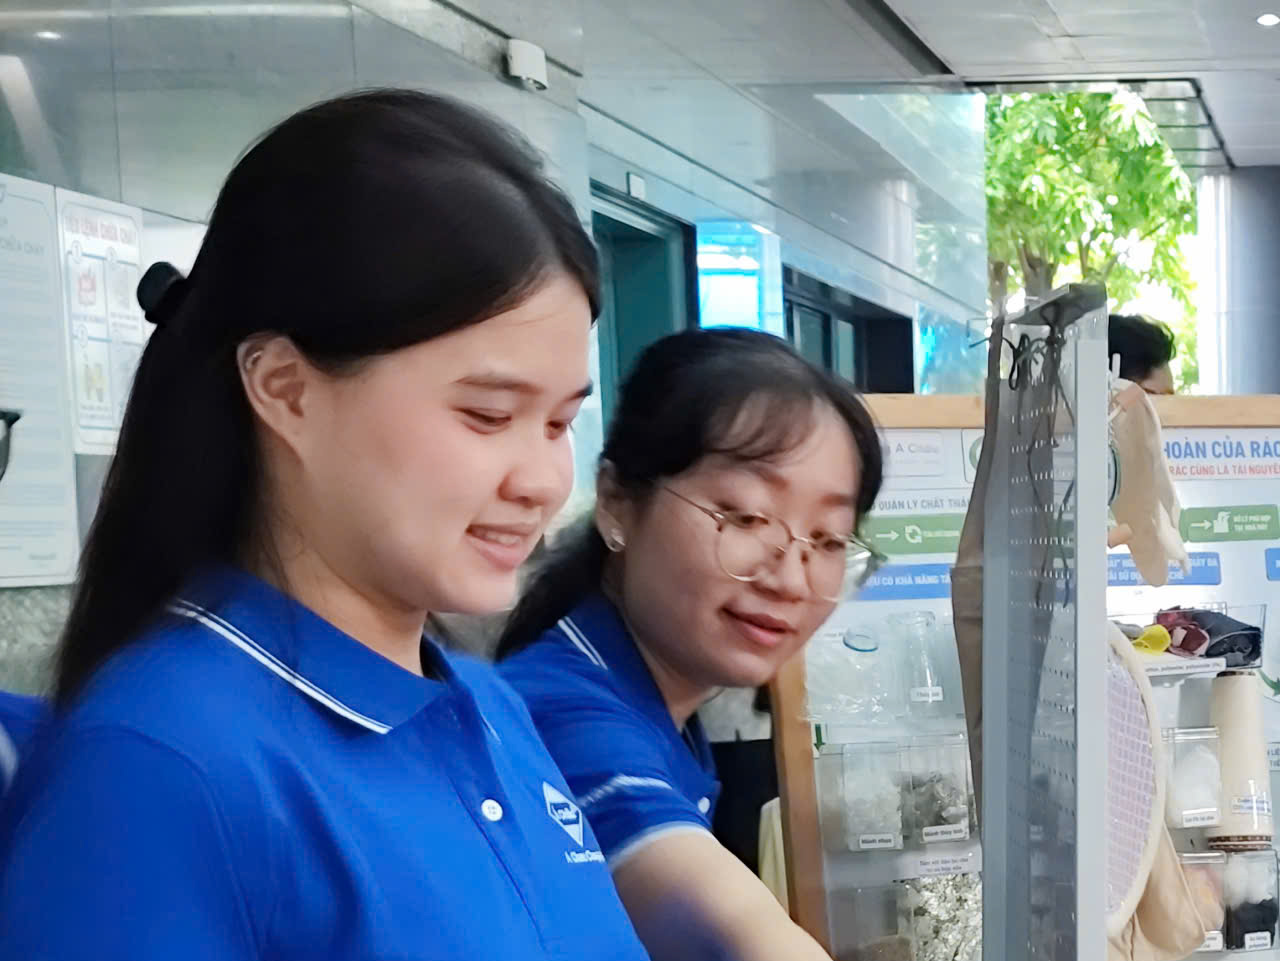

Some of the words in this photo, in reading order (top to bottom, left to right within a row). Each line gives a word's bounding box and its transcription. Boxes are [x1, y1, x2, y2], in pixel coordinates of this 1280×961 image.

[1164, 436, 1207, 458] HOÀN
[1211, 435, 1246, 458] CỦA
[949, 496, 968, 508] THẢ
